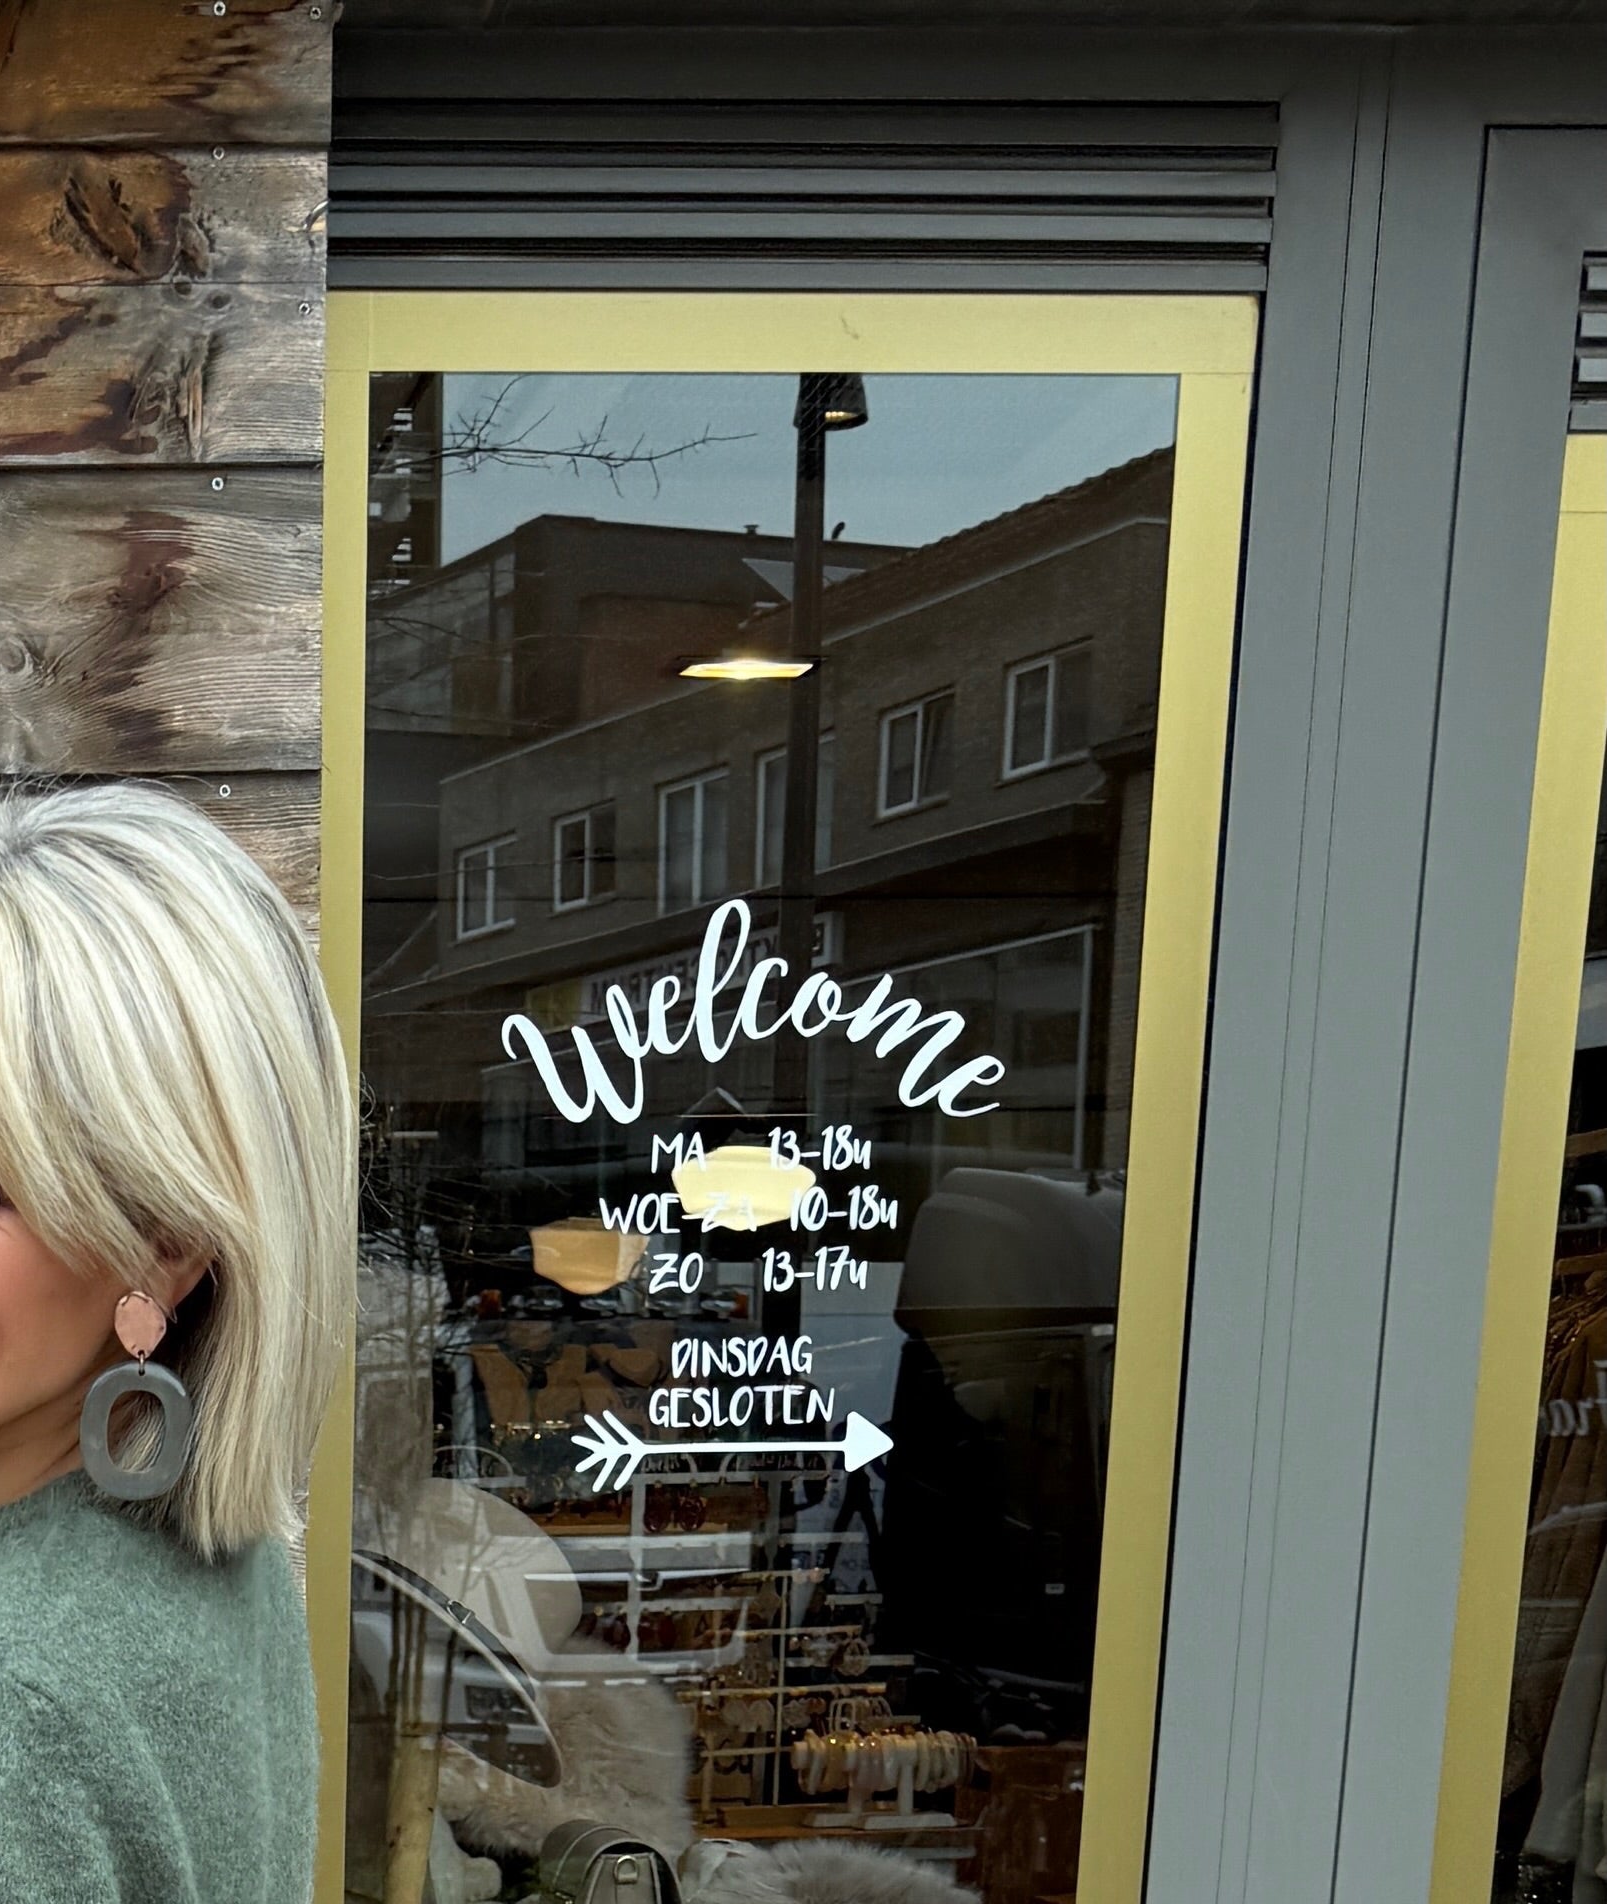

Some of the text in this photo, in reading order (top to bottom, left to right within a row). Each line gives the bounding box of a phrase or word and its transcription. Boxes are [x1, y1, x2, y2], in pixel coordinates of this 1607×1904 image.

[501, 899, 1006, 1124] Welcome
[651, 1124, 872, 1173] MA 13-18u
[789, 1184, 898, 1231] 10-18u
[649, 1245, 869, 1294] ZO 13-17u
[671, 1335, 813, 1379] DINSDAG
[649, 1384, 835, 1428] GESLOTEN
